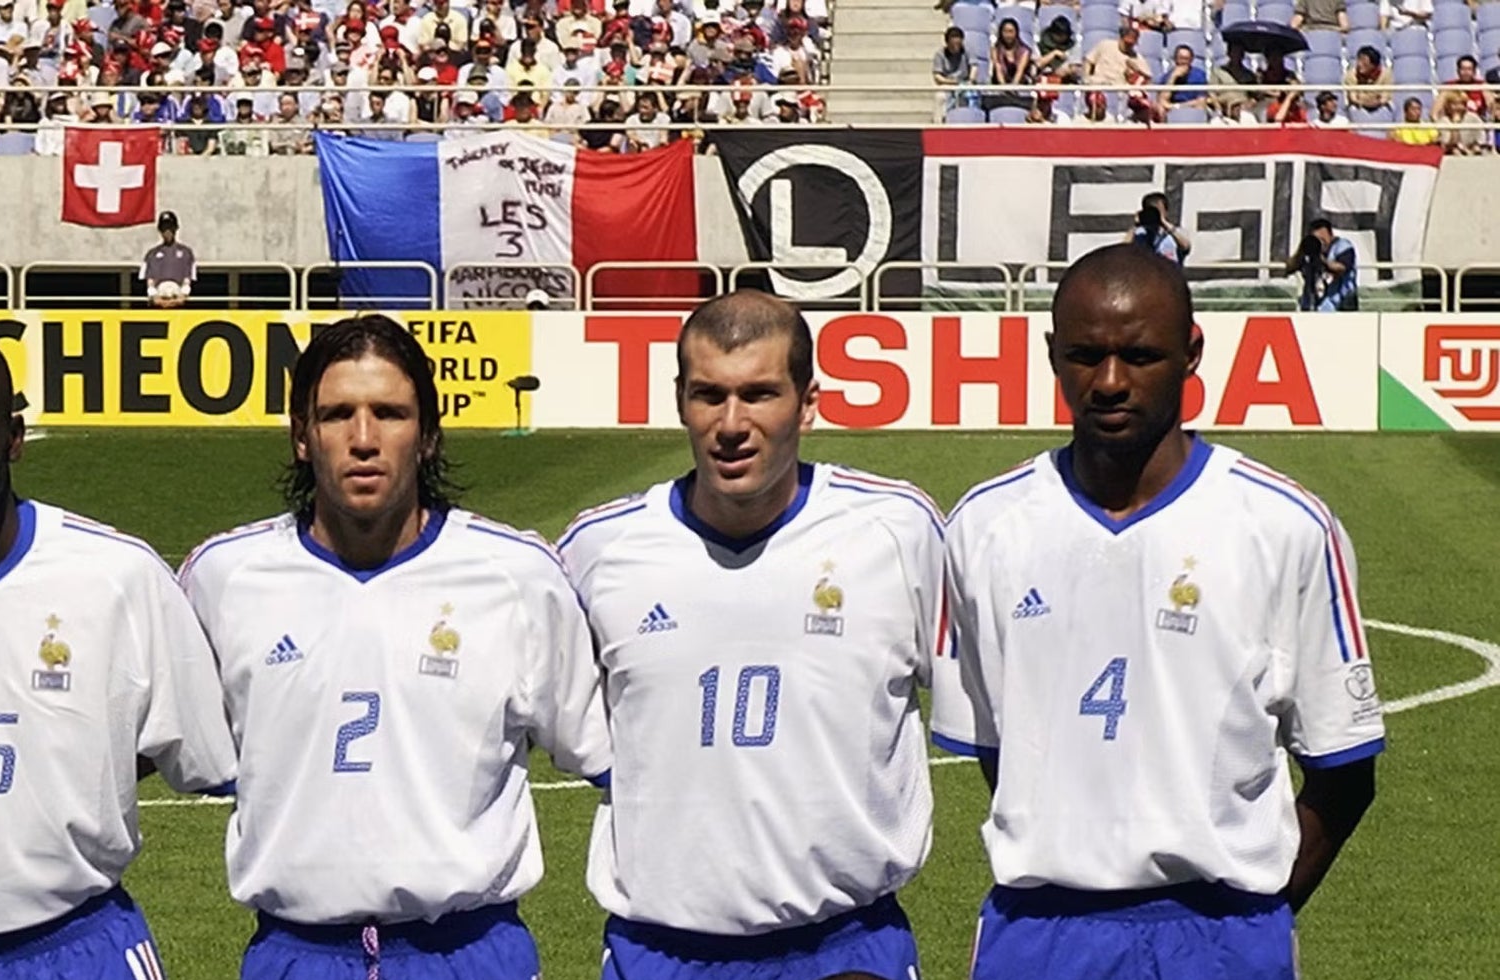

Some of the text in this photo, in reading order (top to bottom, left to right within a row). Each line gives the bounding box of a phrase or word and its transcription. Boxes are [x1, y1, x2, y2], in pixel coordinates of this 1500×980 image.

[480, 201, 548, 231] LES
[495, 230, 524, 258] 3
[409, 321, 477, 345] FIFA
[431, 357, 499, 382] ORLD
[584, 314, 1323, 430] TSHA
[698, 664, 782, 748] 10
[1078, 656, 1130, 742] 4
[332, 690, 382, 773] 2
